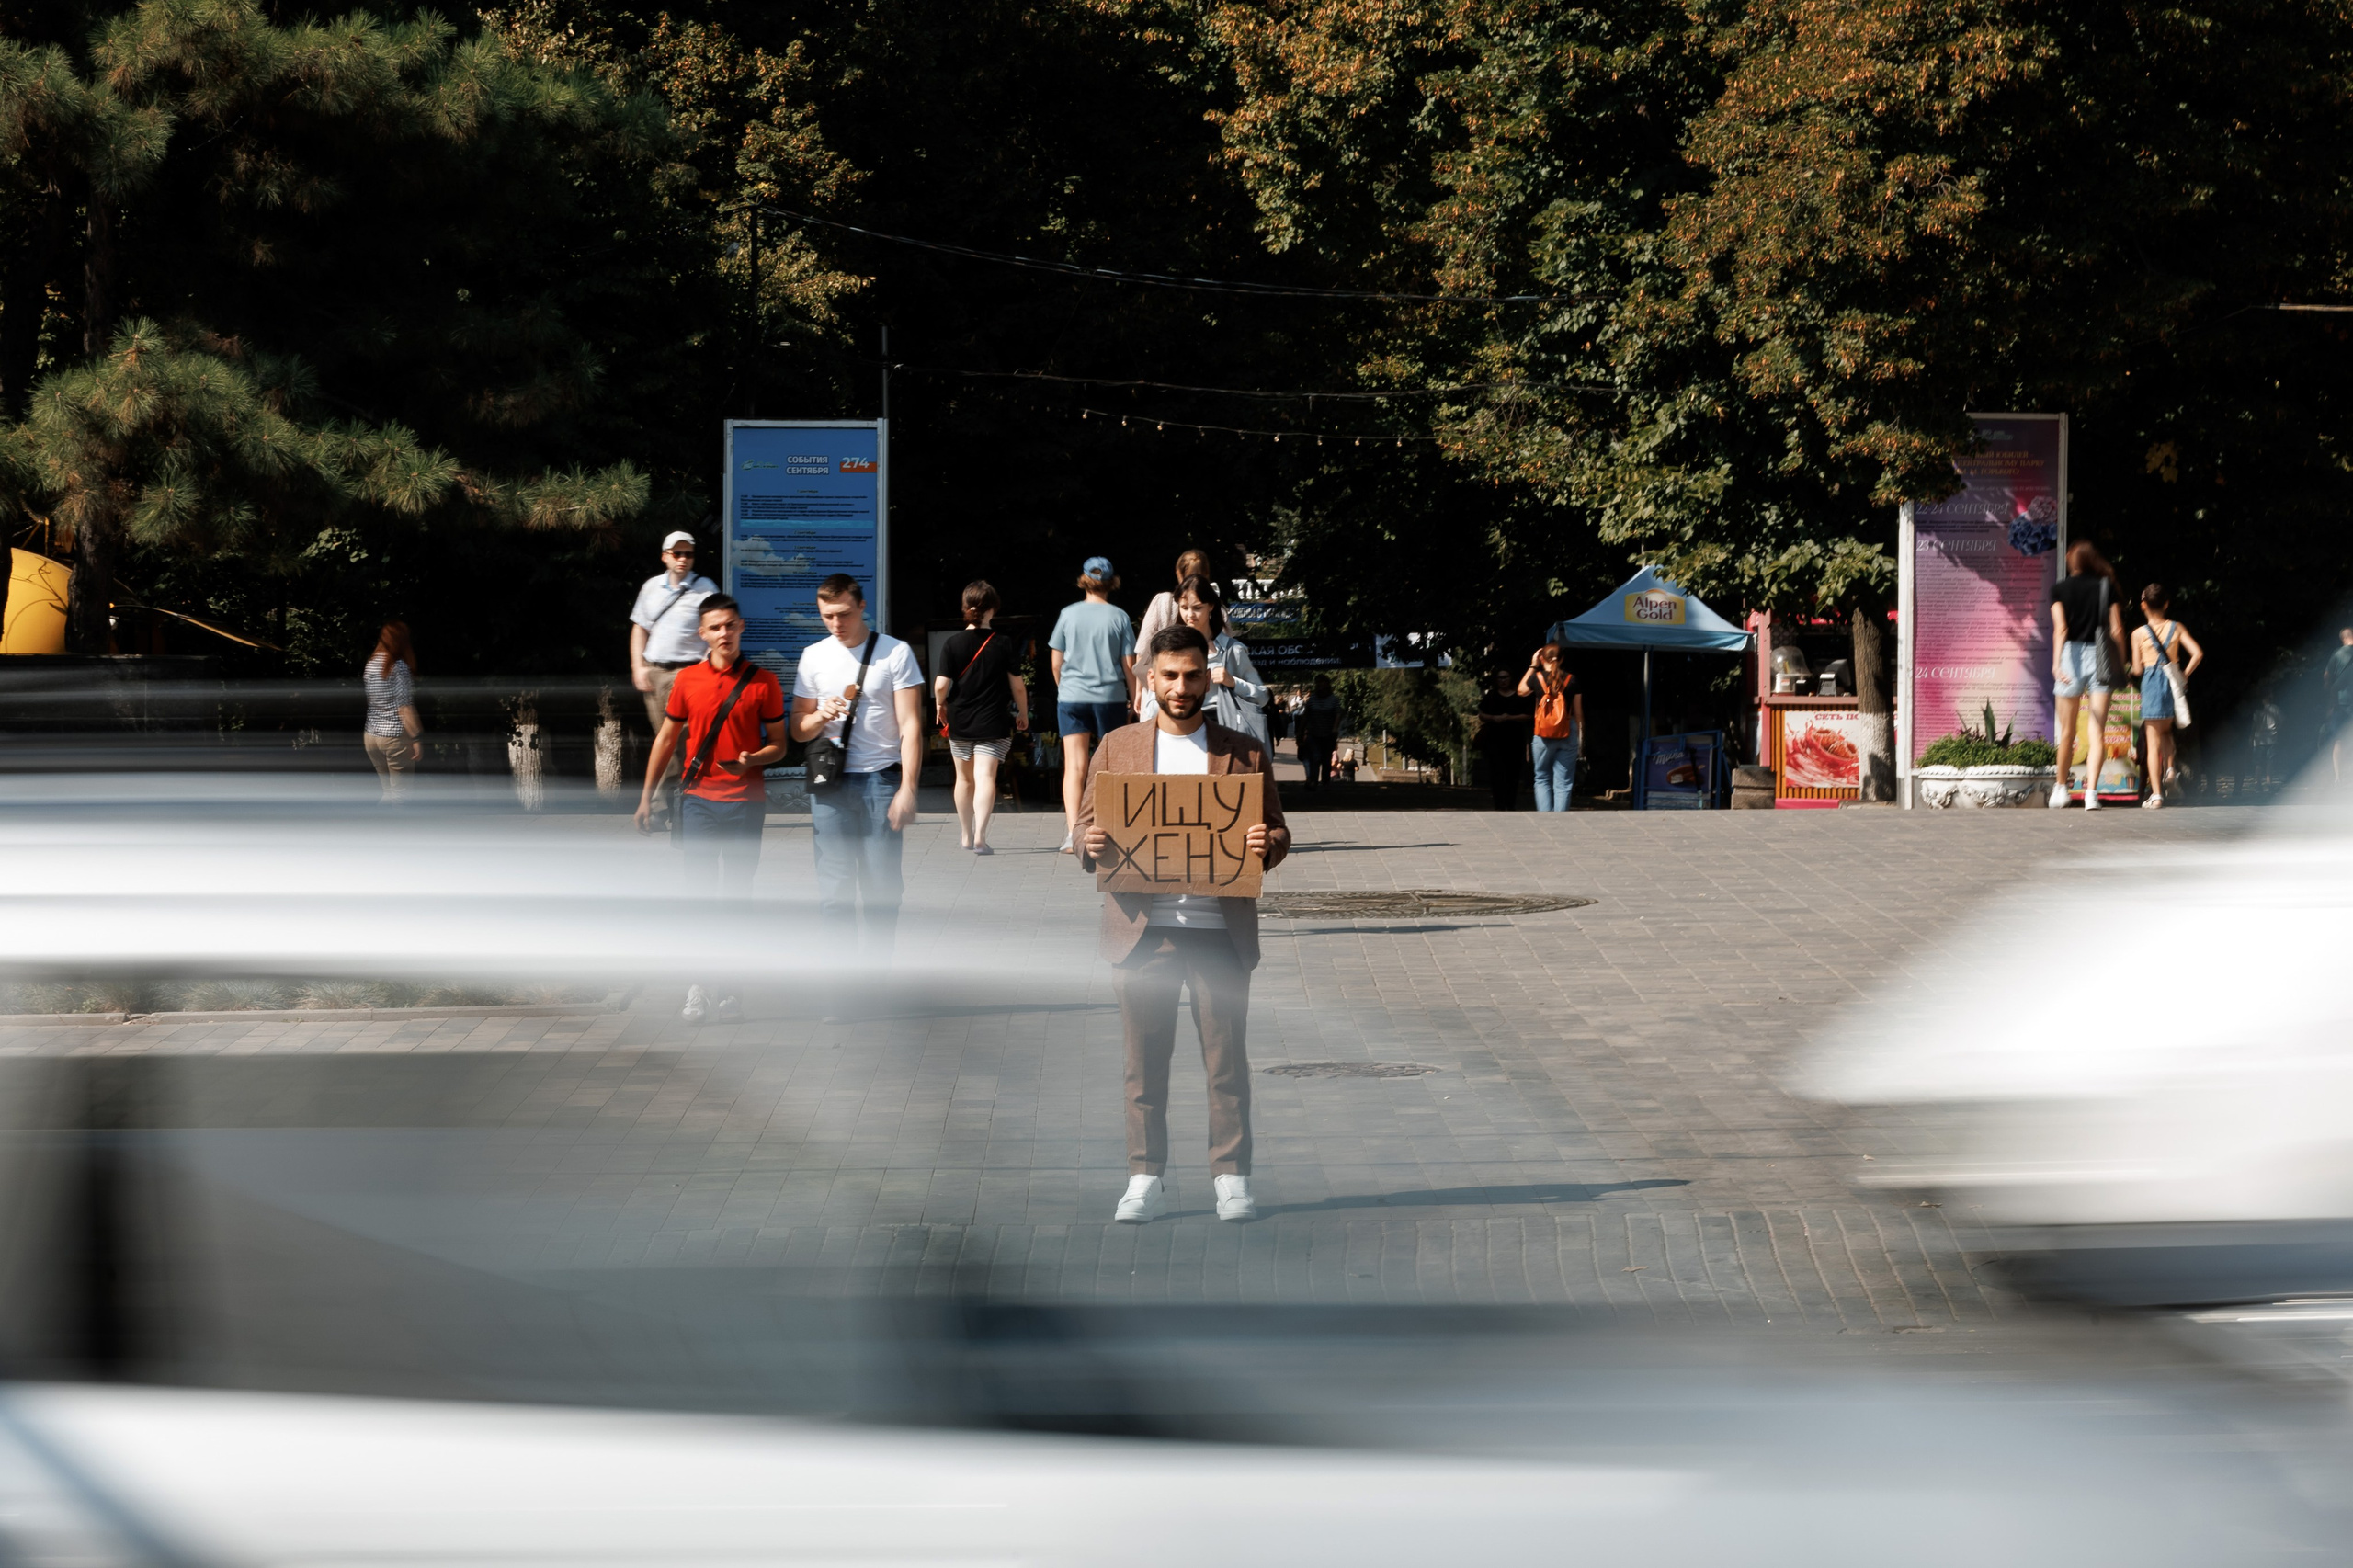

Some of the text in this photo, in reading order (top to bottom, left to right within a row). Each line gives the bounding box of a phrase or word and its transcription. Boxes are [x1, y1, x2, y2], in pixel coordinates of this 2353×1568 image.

[841, 457, 870, 469] 274
[786, 466, 829, 474] СЕНТЯБРЯ
[1632, 596, 1677, 611] Alpen
[1636, 608, 1673, 620] Gold
[1915, 667, 1928, 679] 24
[1123, 781, 1245, 833] ИЩУ
[1103, 831, 1248, 887] ЖЕНУ
